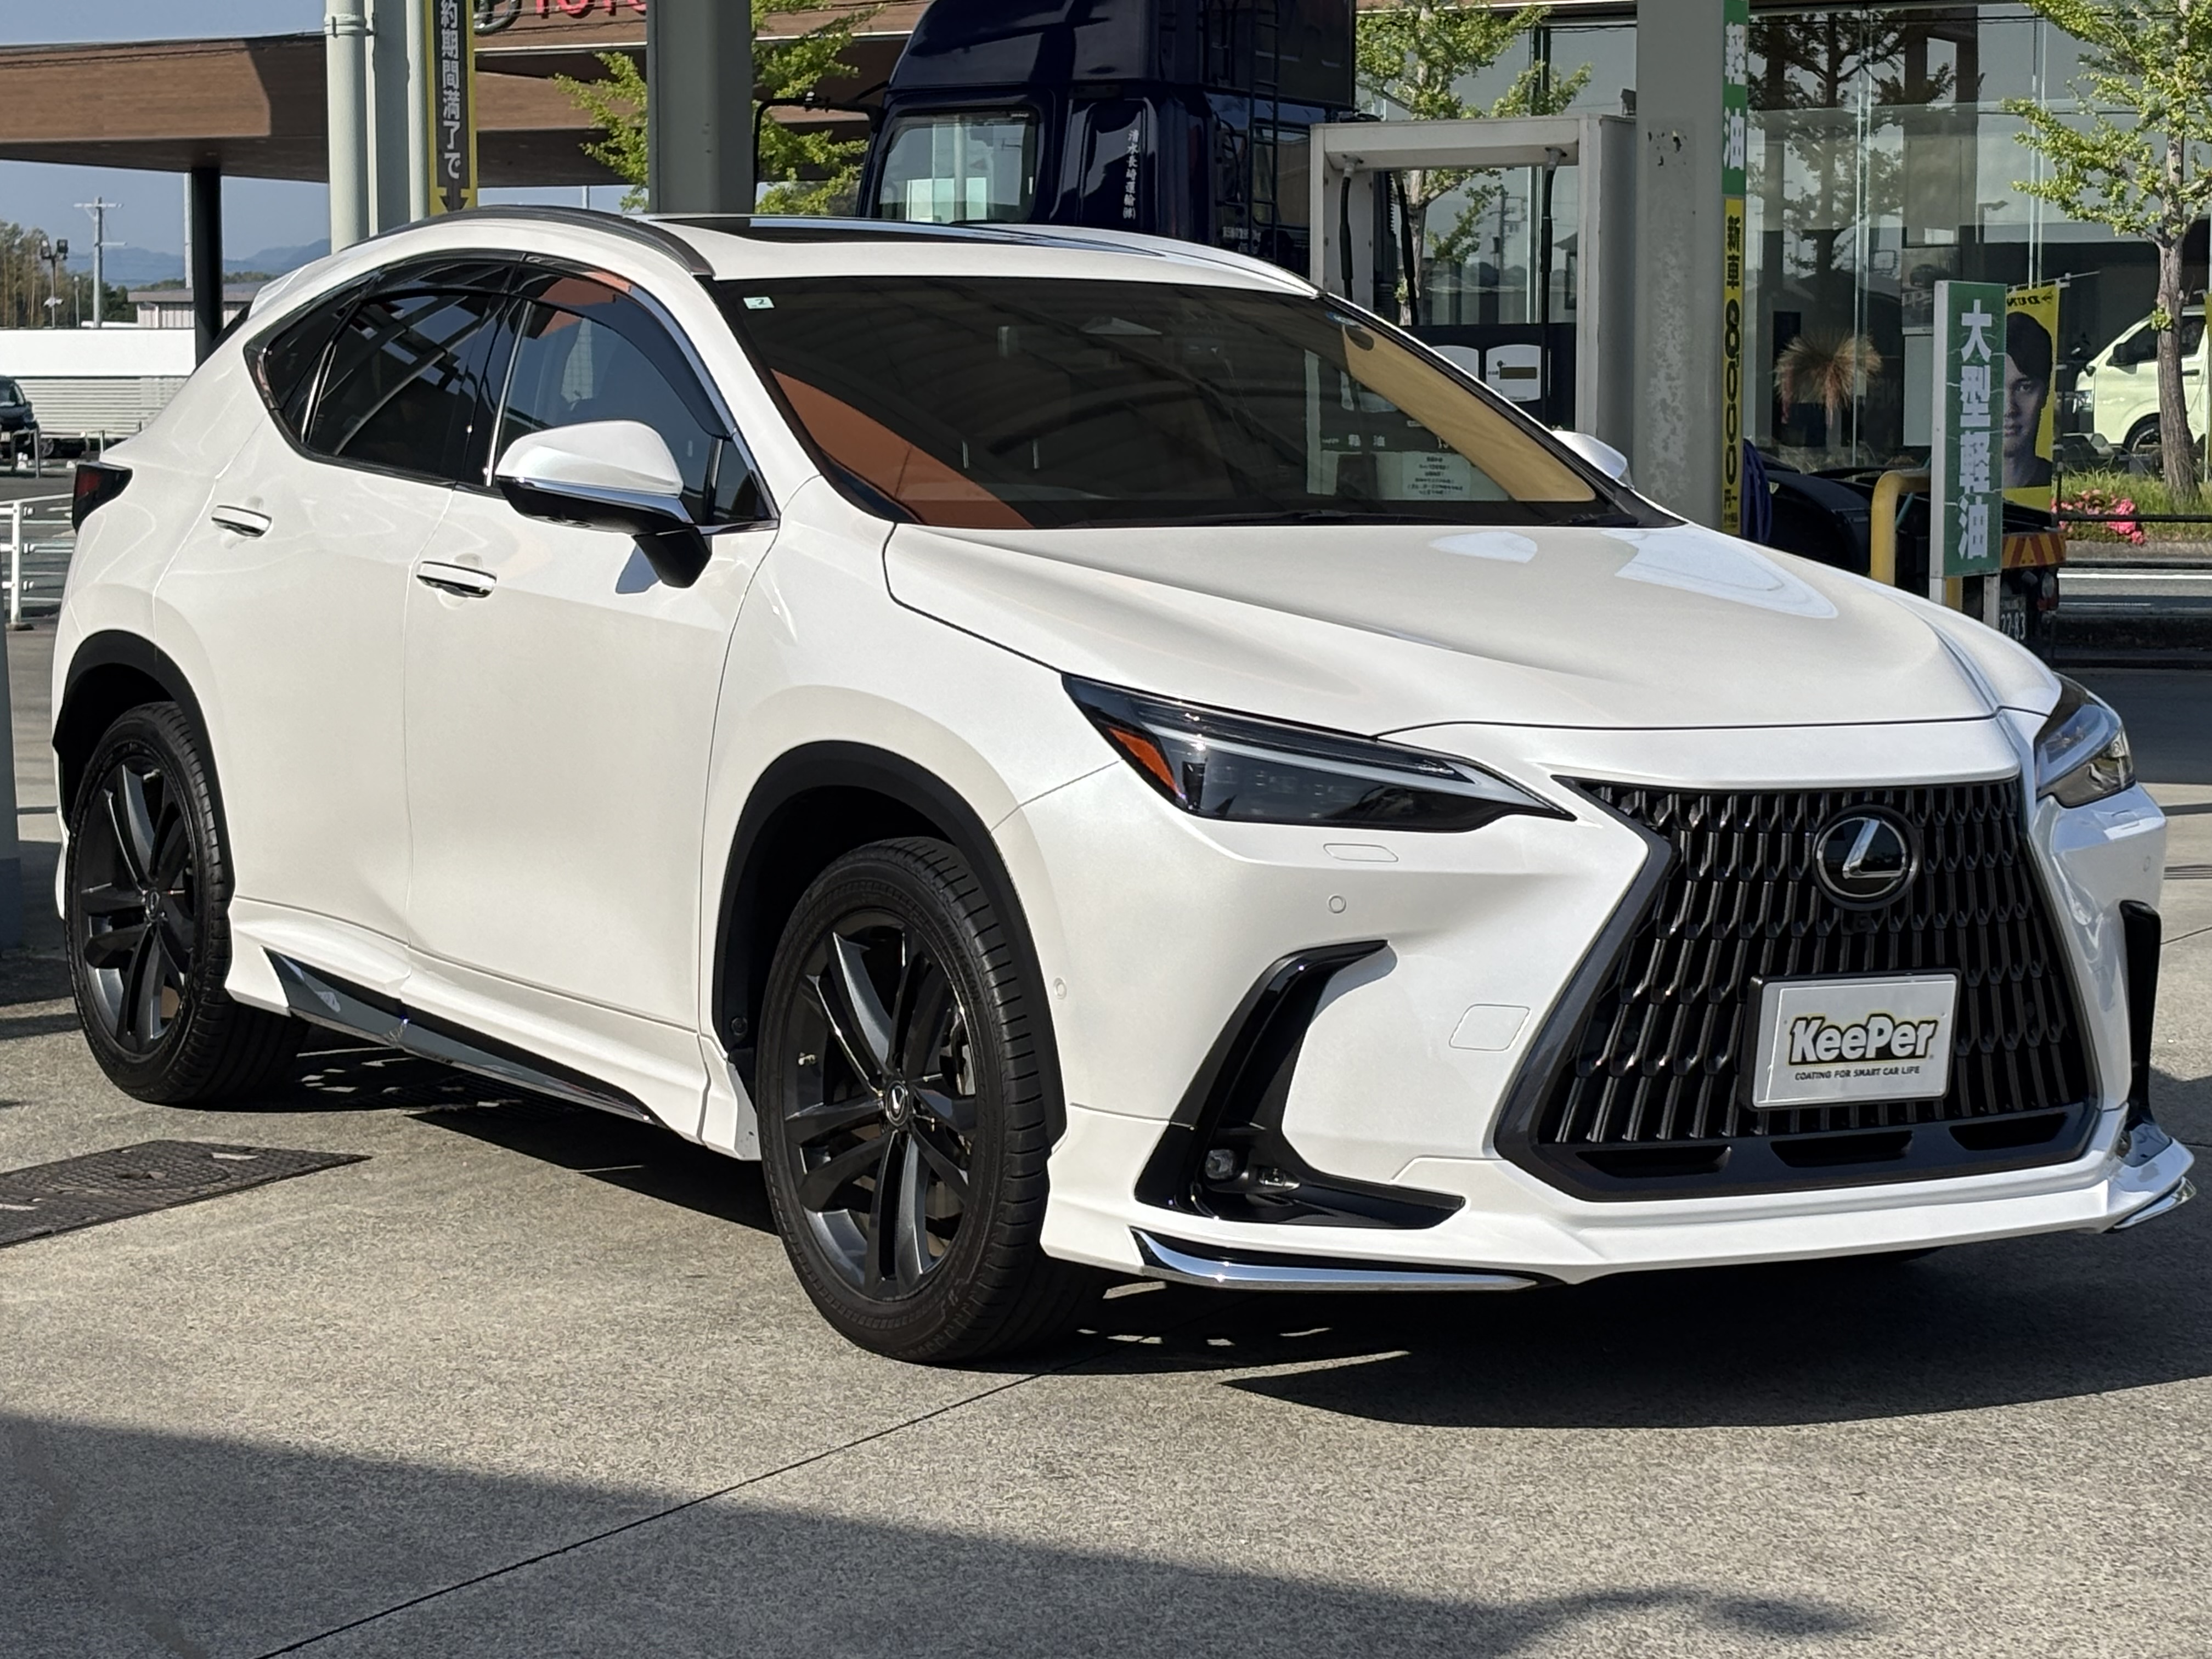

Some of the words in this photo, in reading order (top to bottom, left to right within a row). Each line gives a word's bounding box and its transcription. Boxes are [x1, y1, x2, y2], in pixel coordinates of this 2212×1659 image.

[1723, 20, 1746, 171] 軽油
[1957, 299, 1993, 560] 大型軽油
[1789, 1013, 1938, 1065] KeePer
[1795, 1071, 1832, 1081] COATING
[1833, 1069, 1852, 1079] FOR
[1853, 1068, 1882, 1077] SMART
[1883, 1066, 1899, 1076] CAR
[1901, 1065, 1920, 1075] LIFE
